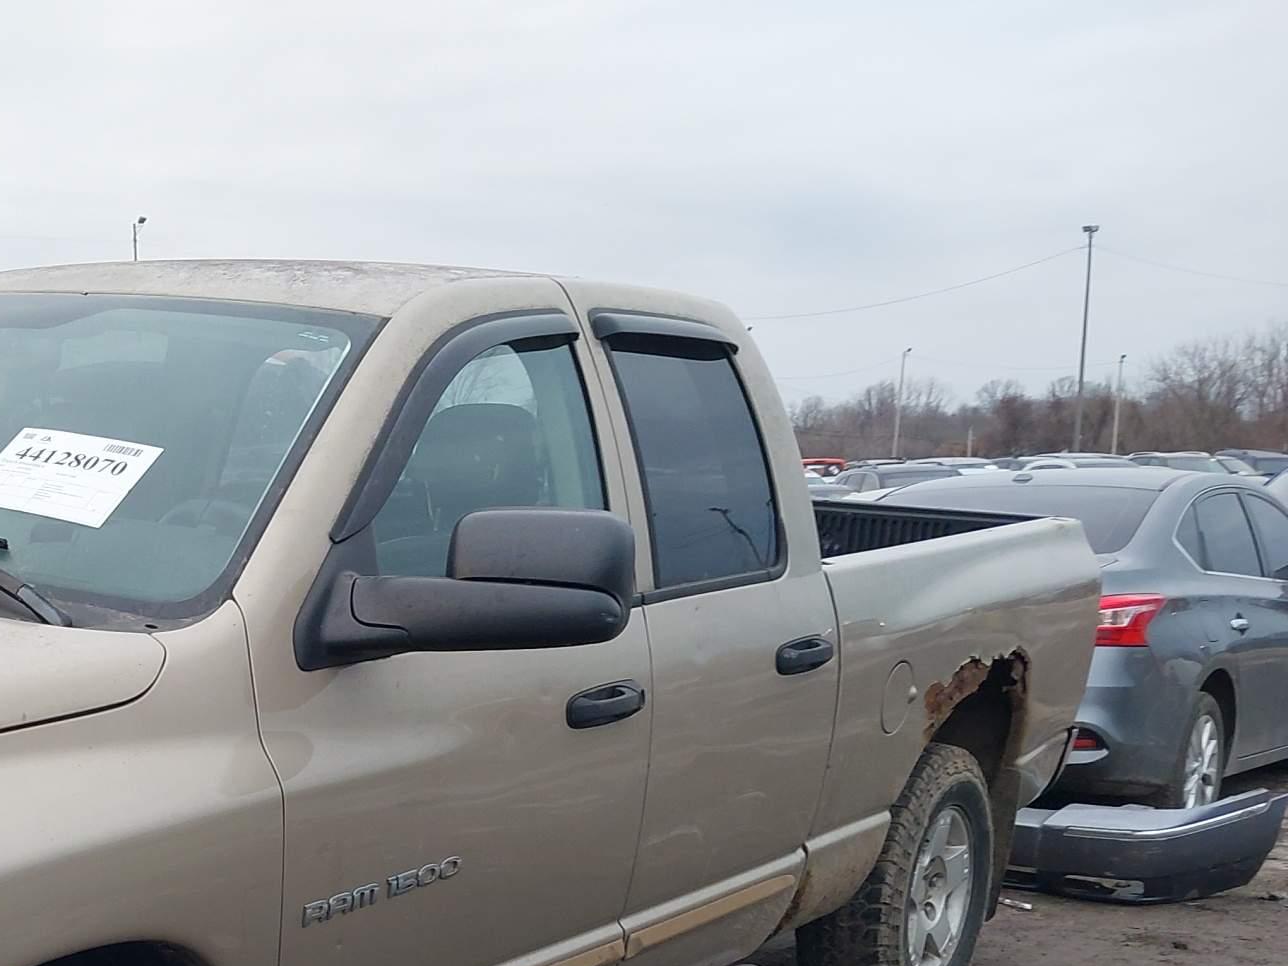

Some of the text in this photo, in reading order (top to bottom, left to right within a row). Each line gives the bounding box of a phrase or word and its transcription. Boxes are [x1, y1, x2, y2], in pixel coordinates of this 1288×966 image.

[15, 446, 128, 476] 44128070
[302, 856, 462, 928] RAM 1500
